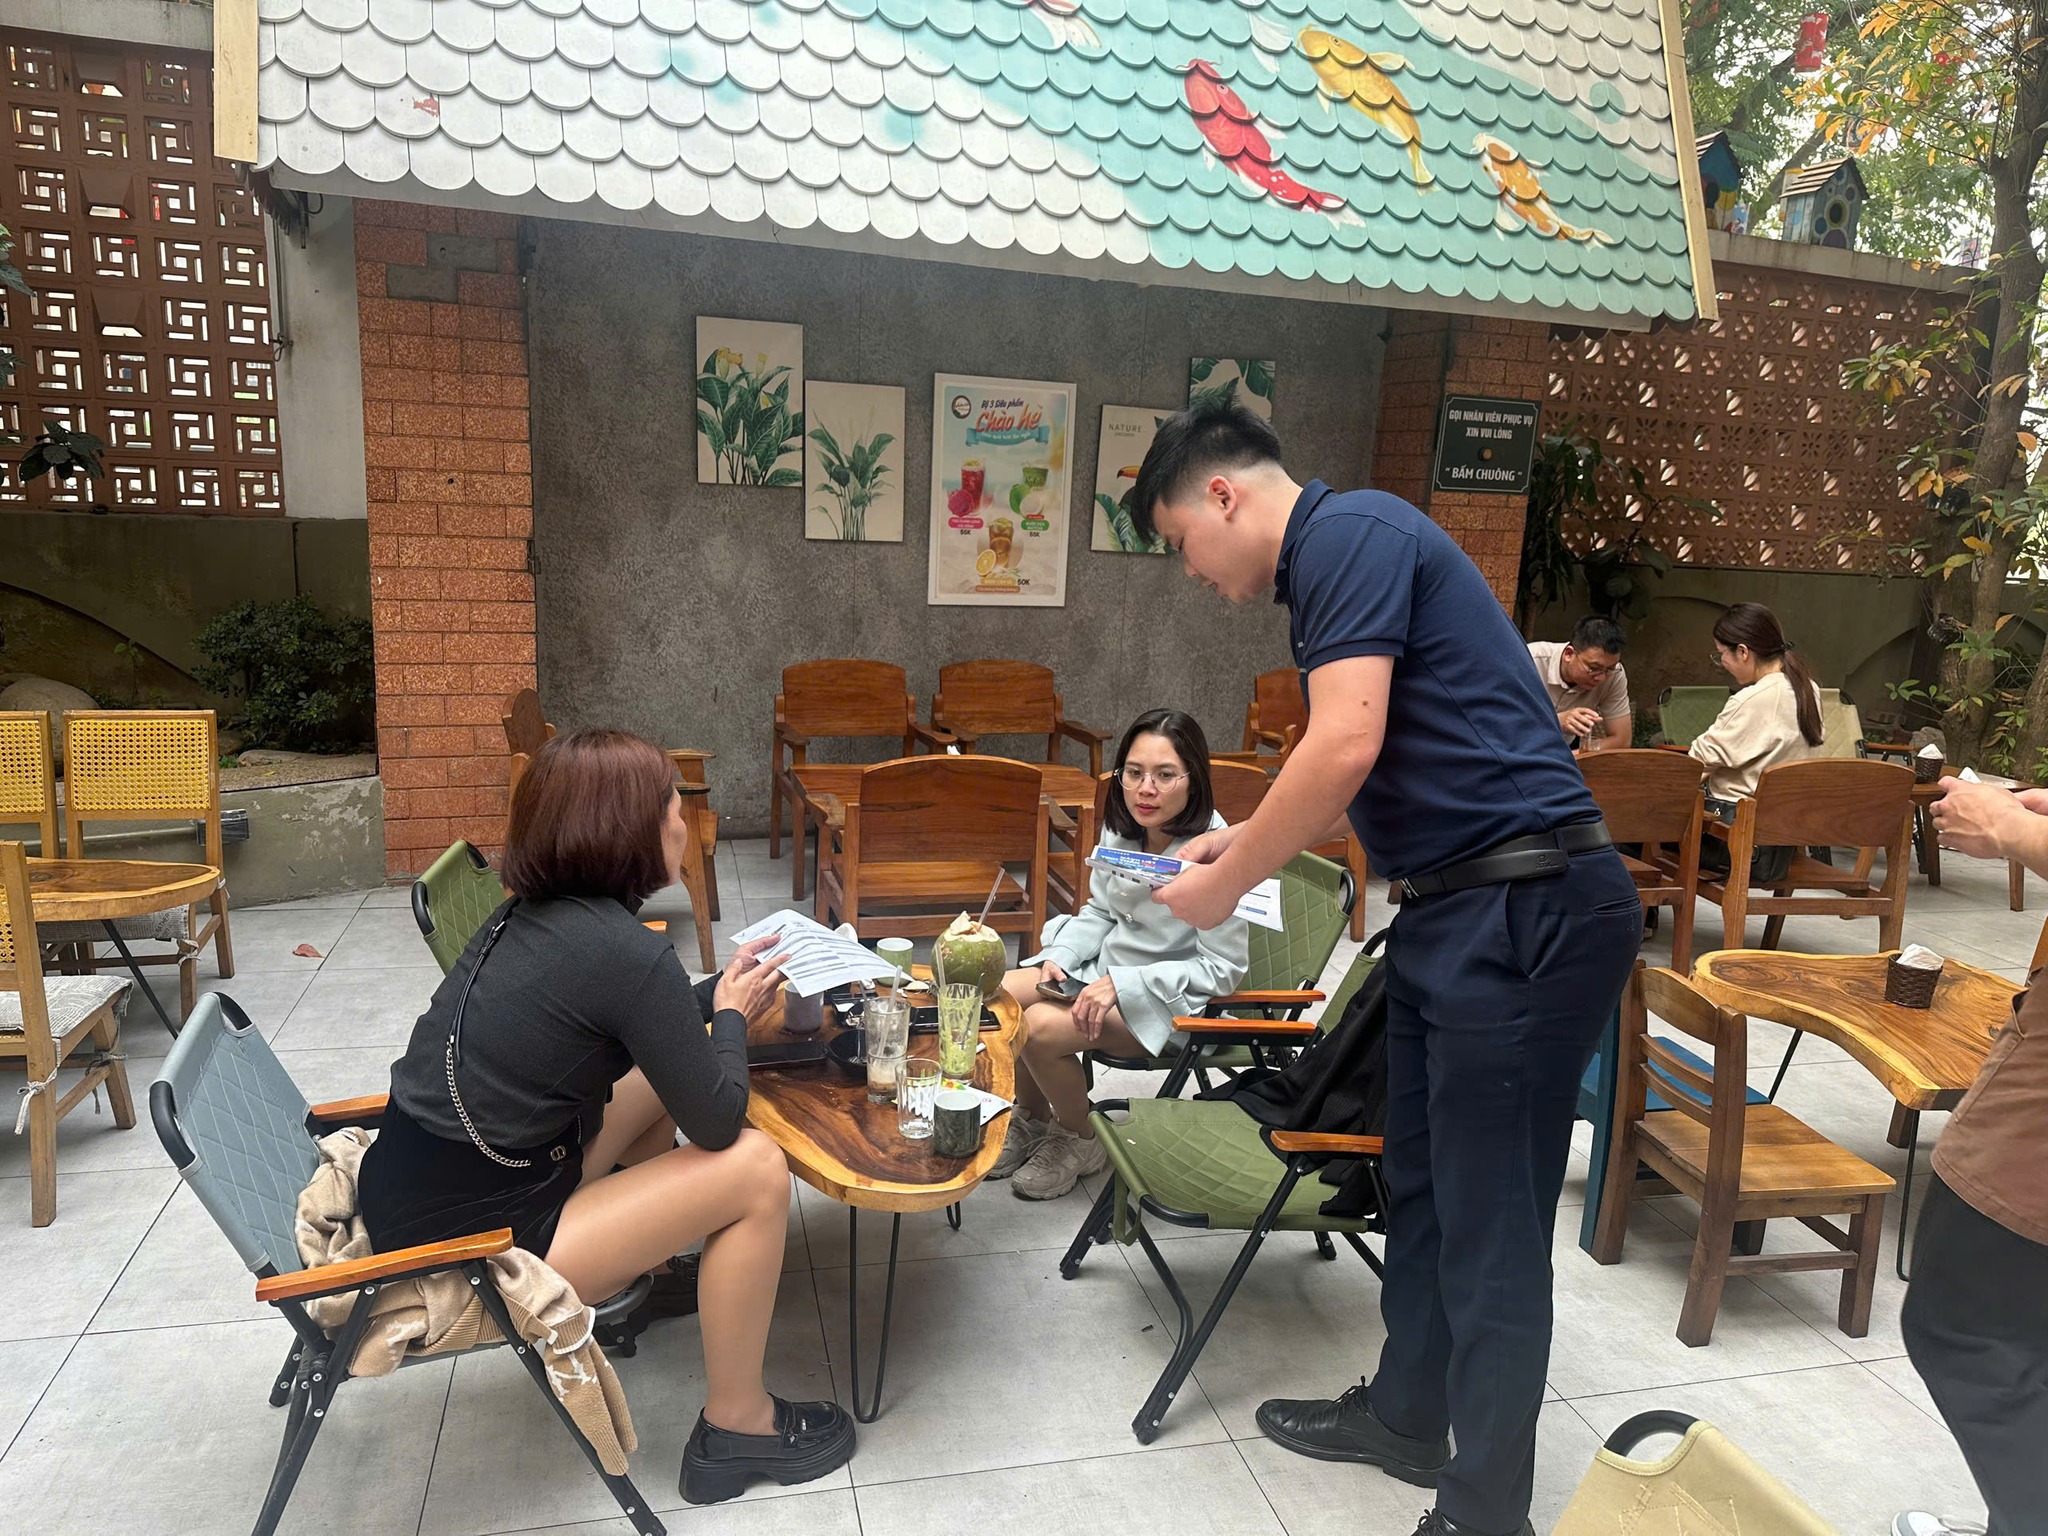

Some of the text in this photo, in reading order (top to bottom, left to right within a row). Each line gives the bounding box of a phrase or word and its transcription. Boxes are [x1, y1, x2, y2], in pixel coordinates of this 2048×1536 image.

[976, 403, 1044, 432] Chào hè
[1449, 409, 1534, 427] GỌI NHÂN VIÊN PHỤC VỤ
[1109, 423, 1143, 433] NATURE
[1466, 427, 1513, 439] XIN VUI LÒNG
[1452, 464, 1474, 479] BẤM
[1476, 467, 1515, 481] CHUÔNG
[1018, 578, 1030, 586] 50K
